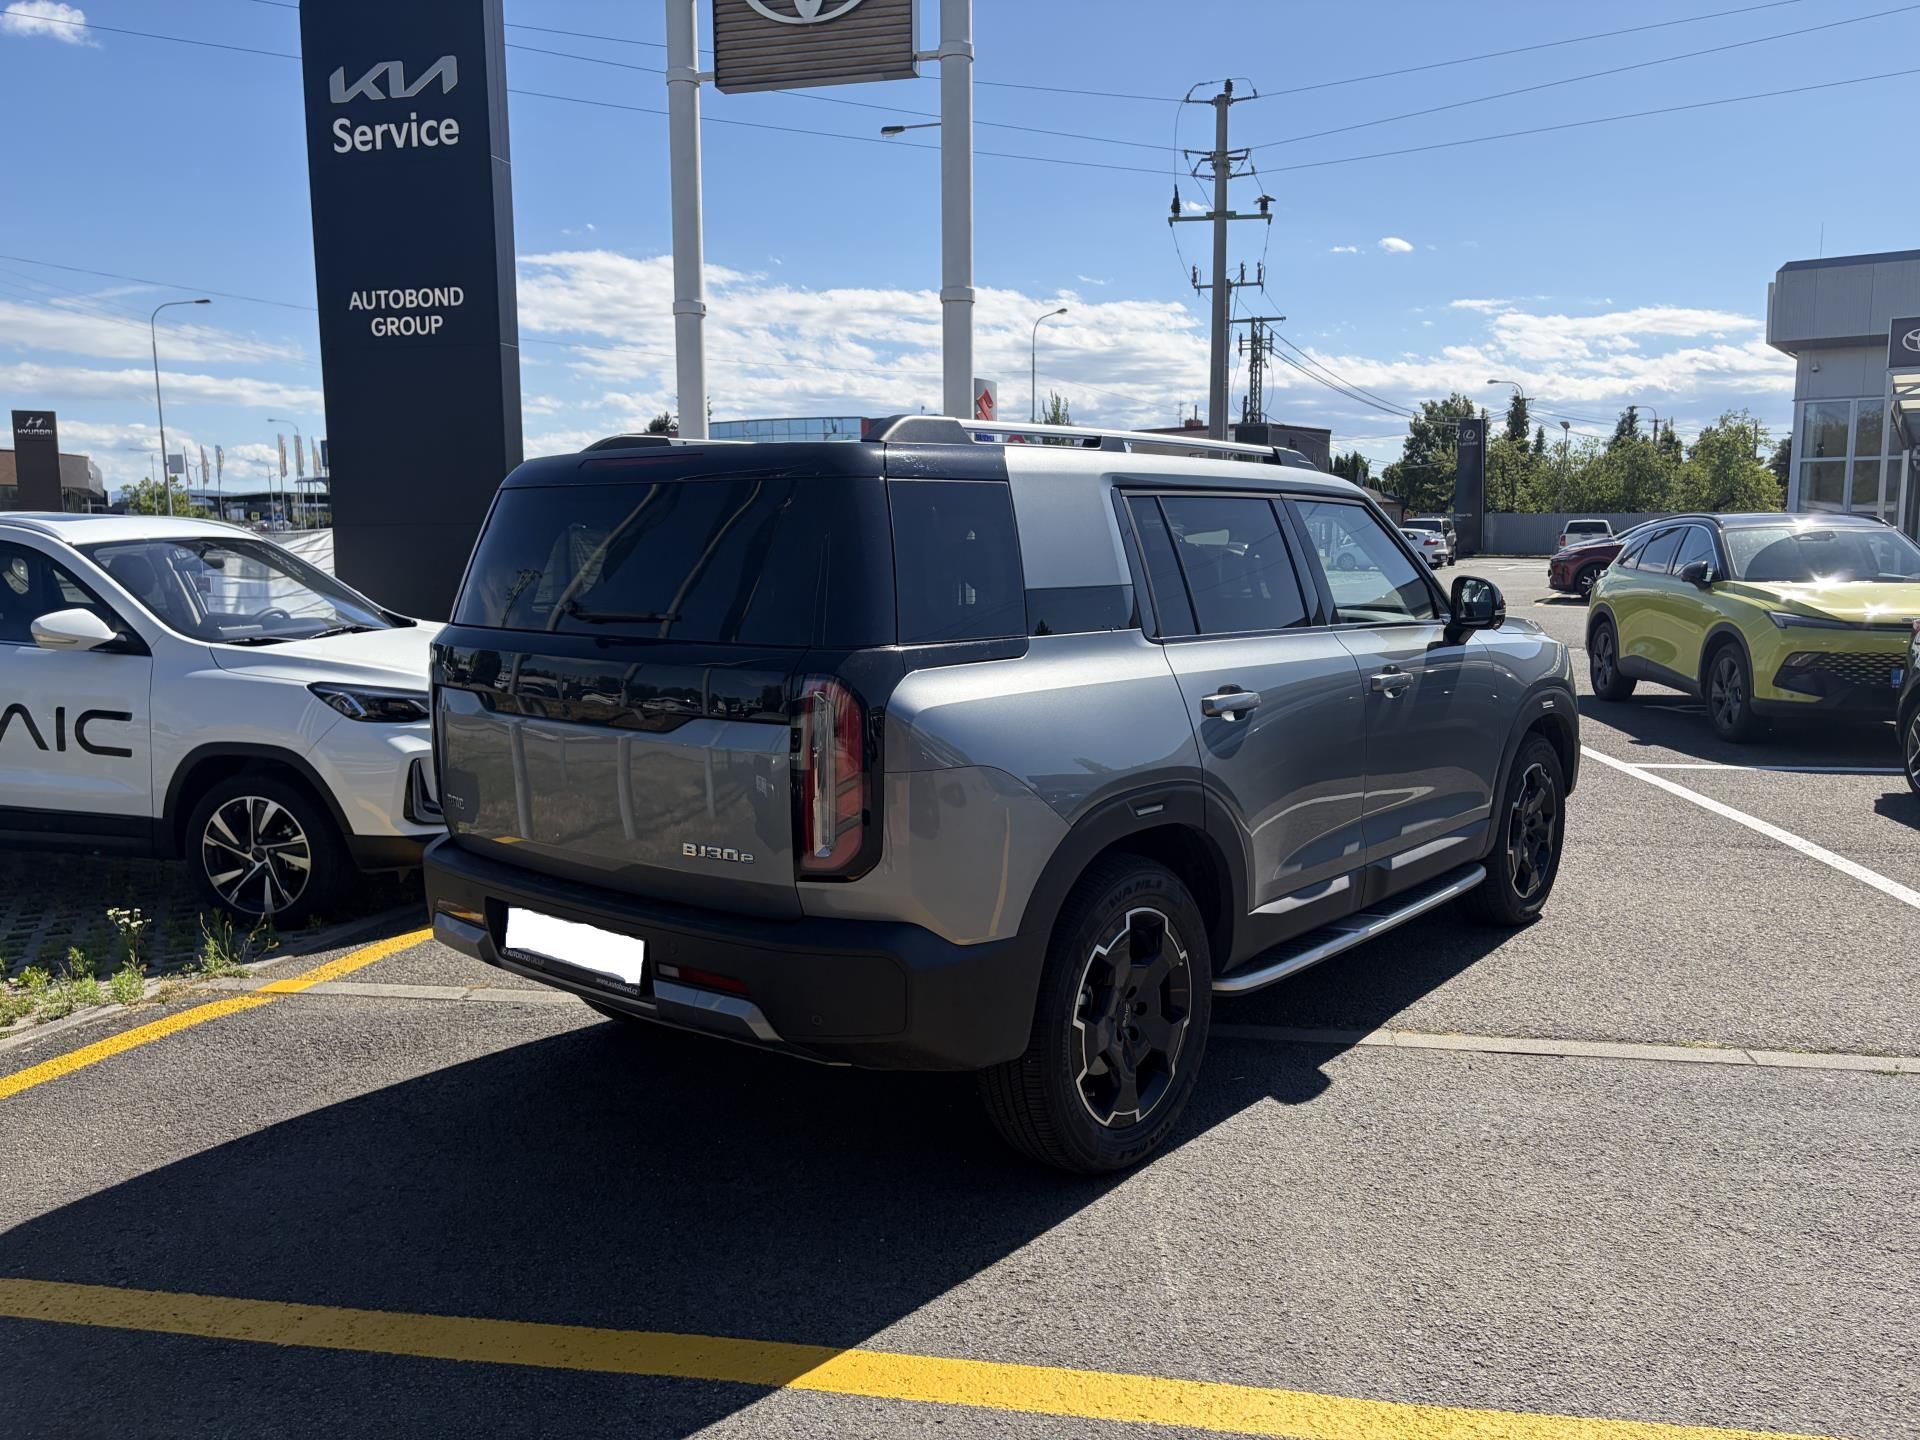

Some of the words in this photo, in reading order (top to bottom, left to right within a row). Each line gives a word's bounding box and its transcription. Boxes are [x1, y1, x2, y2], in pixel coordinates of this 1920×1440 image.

[329, 55, 458, 104] KIA
[332, 112, 460, 154] Service
[348, 286, 465, 311] AUTOBOND
[371, 315, 444, 337] GROUP
[17, 428, 53, 436] HYUNDAI
[682, 842, 755, 864] BJ30e
